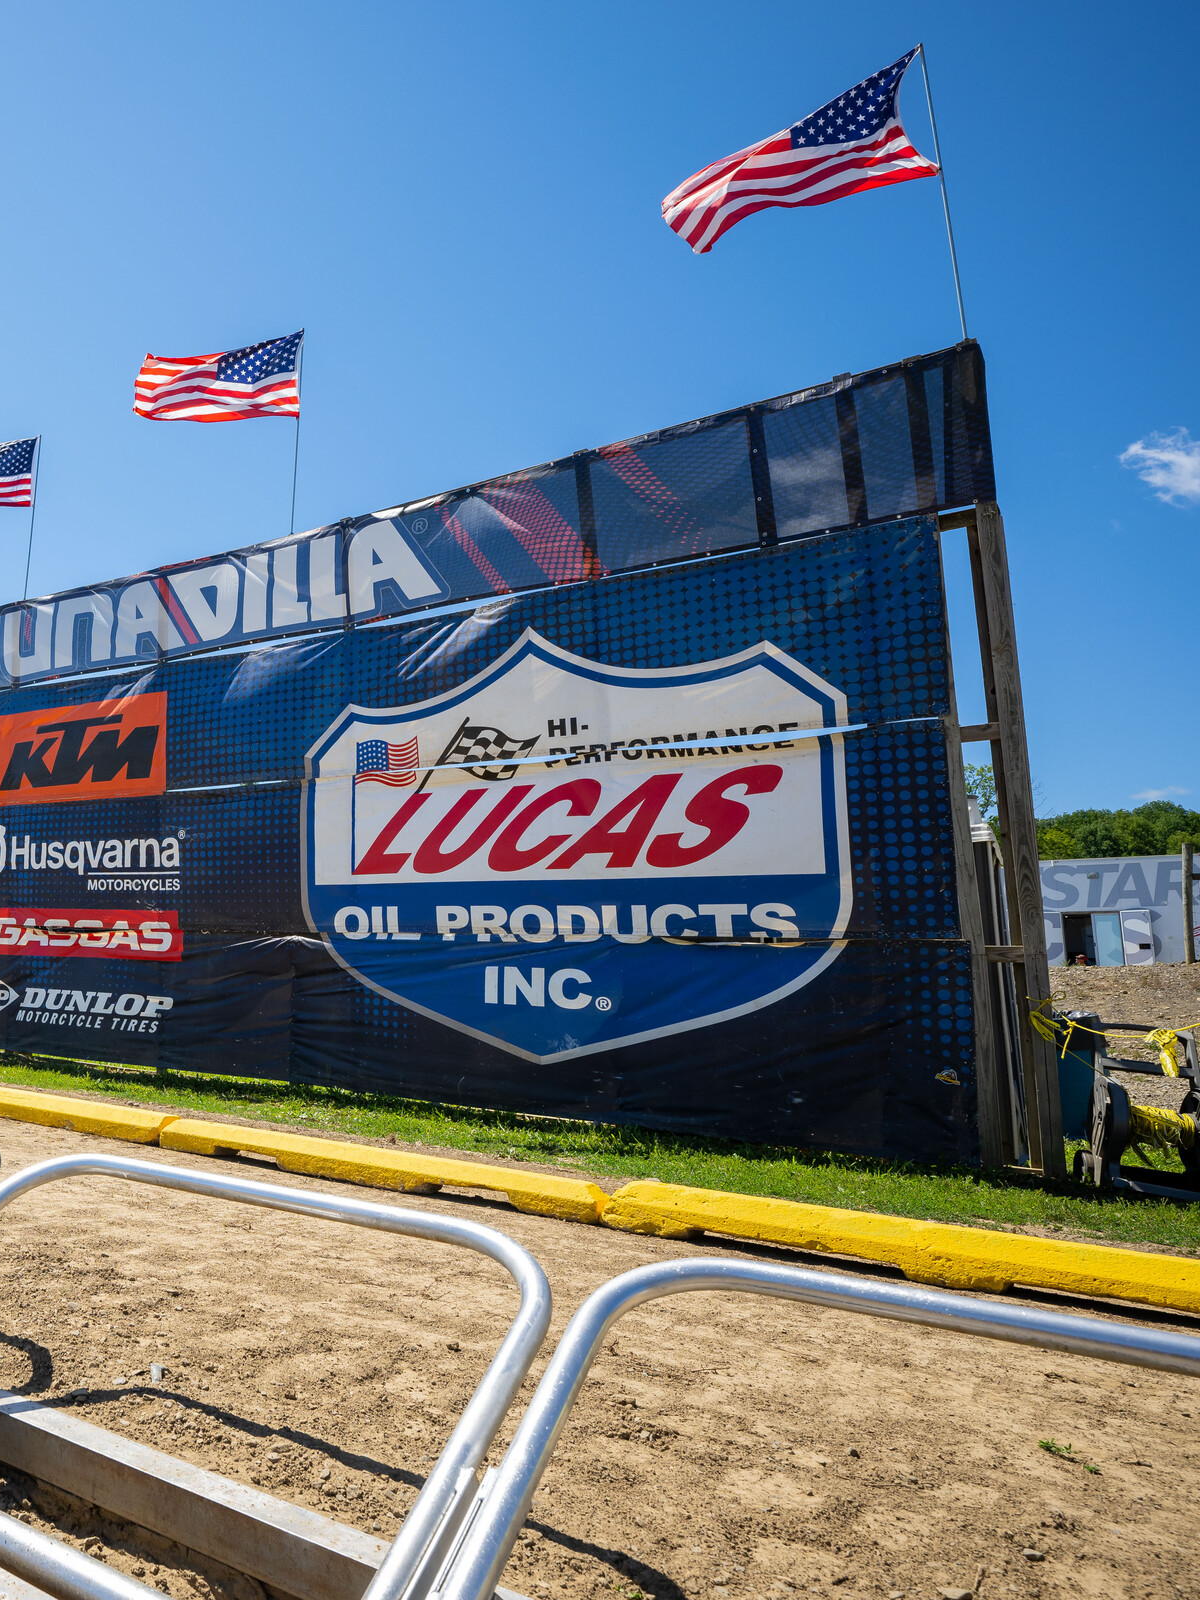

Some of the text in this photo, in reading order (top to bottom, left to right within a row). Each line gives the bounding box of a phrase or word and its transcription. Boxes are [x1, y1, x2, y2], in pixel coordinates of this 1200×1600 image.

[3, 519, 442, 677] UNADILLA
[547, 717, 589, 737] HI-
[0, 715, 160, 791] KTM
[351, 764, 783, 875] LUCAS
[11, 835, 180, 876] Husqvarna
[87, 879, 181, 891] MOTORCYCLES
[333, 902, 805, 948] OIL PRODUCTS
[15, 1010, 160, 1034] MOTORCYCLE TIRES
[20, 987, 174, 1018] DUNLOP
